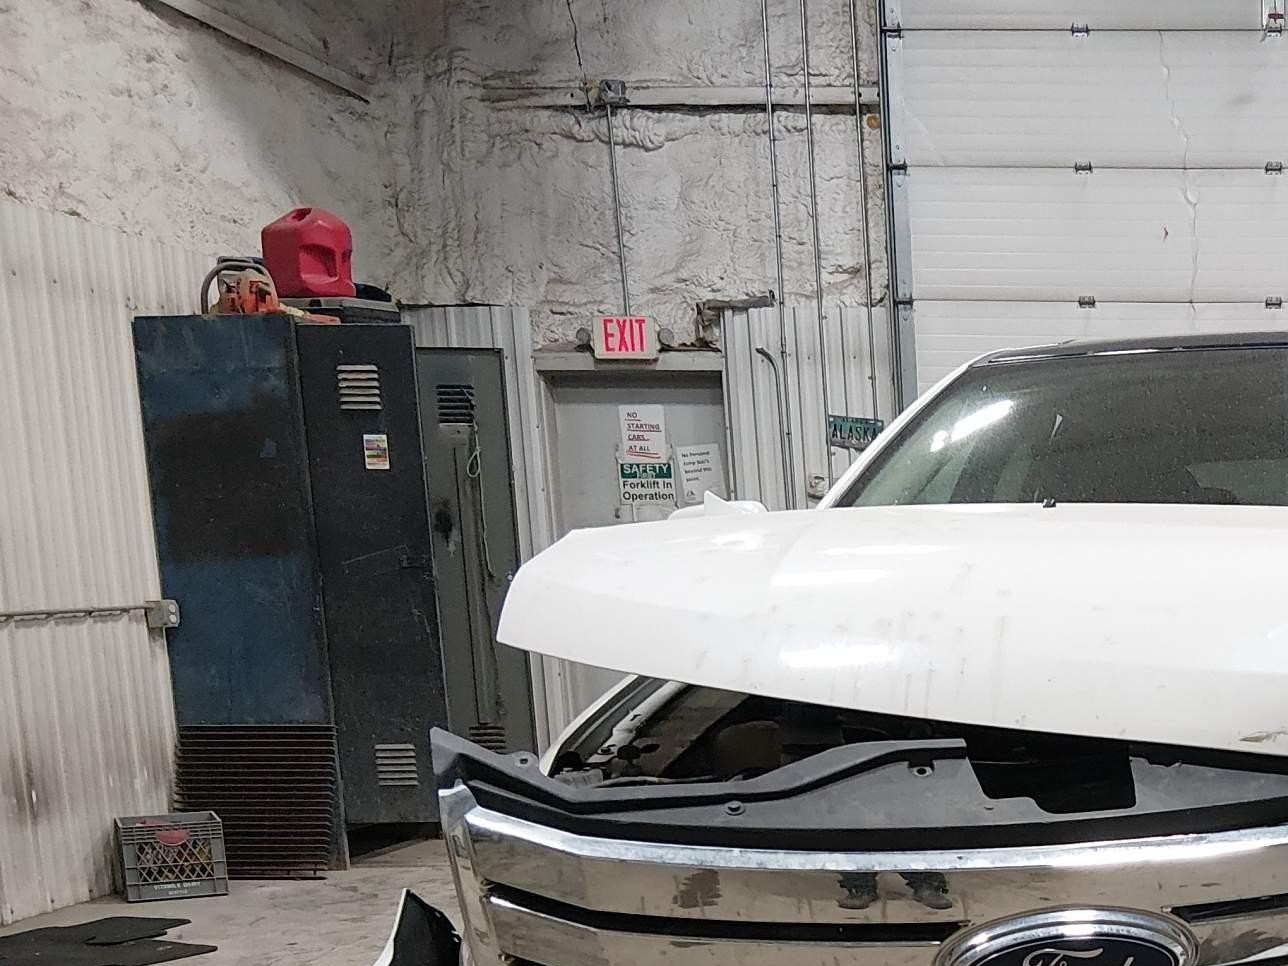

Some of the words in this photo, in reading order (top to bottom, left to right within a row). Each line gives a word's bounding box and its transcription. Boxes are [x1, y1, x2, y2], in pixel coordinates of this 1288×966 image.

[603, 319, 645, 352] EXIT
[832, 424, 877, 441] ALASKA
[623, 464, 669, 474] SAFETY
[622, 480, 660, 489] Forklift
[663, 480, 672, 489] In
[622, 491, 674, 502] Operation
